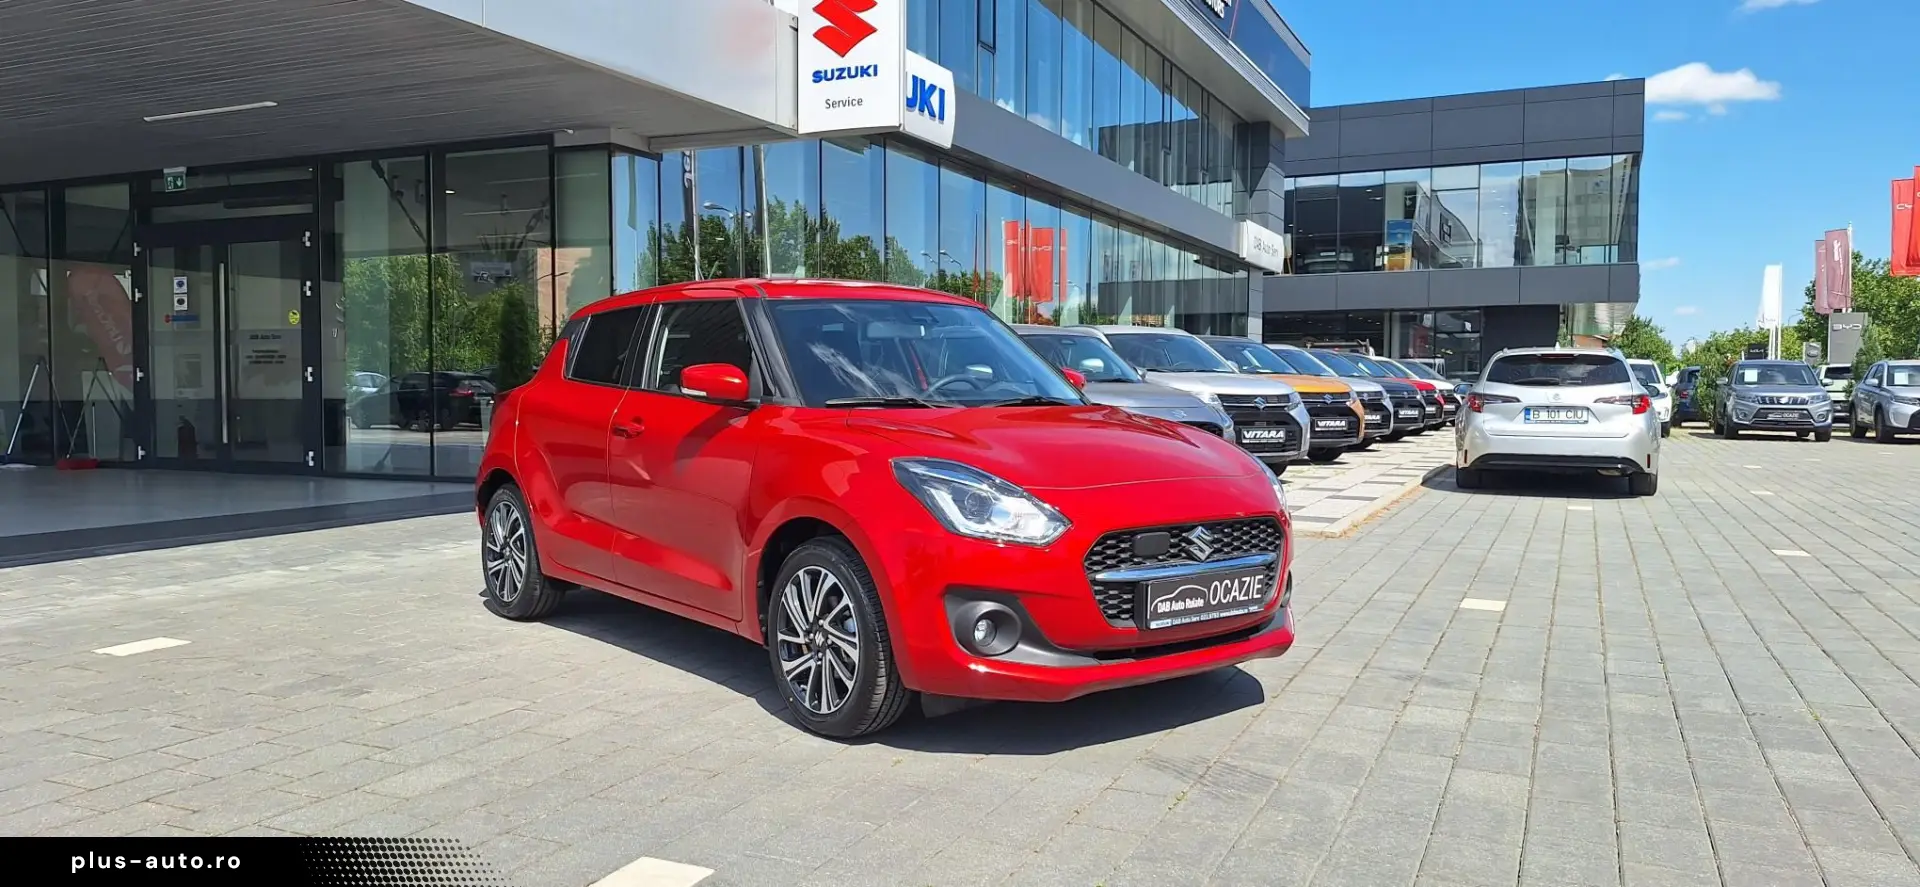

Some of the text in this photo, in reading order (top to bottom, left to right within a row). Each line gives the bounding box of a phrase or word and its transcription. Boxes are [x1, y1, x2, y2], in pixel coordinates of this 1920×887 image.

[812, 64, 878, 83] SUZUKI
[825, 97, 863, 109] Service
[1533, 410, 1583, 419] B 101 CIU
[1243, 430, 1284, 438] VITARA
[1209, 575, 1264, 605] OCAZIE
[1157, 601, 1171, 613] DAB
[1171, 600, 1185, 611] Auto
